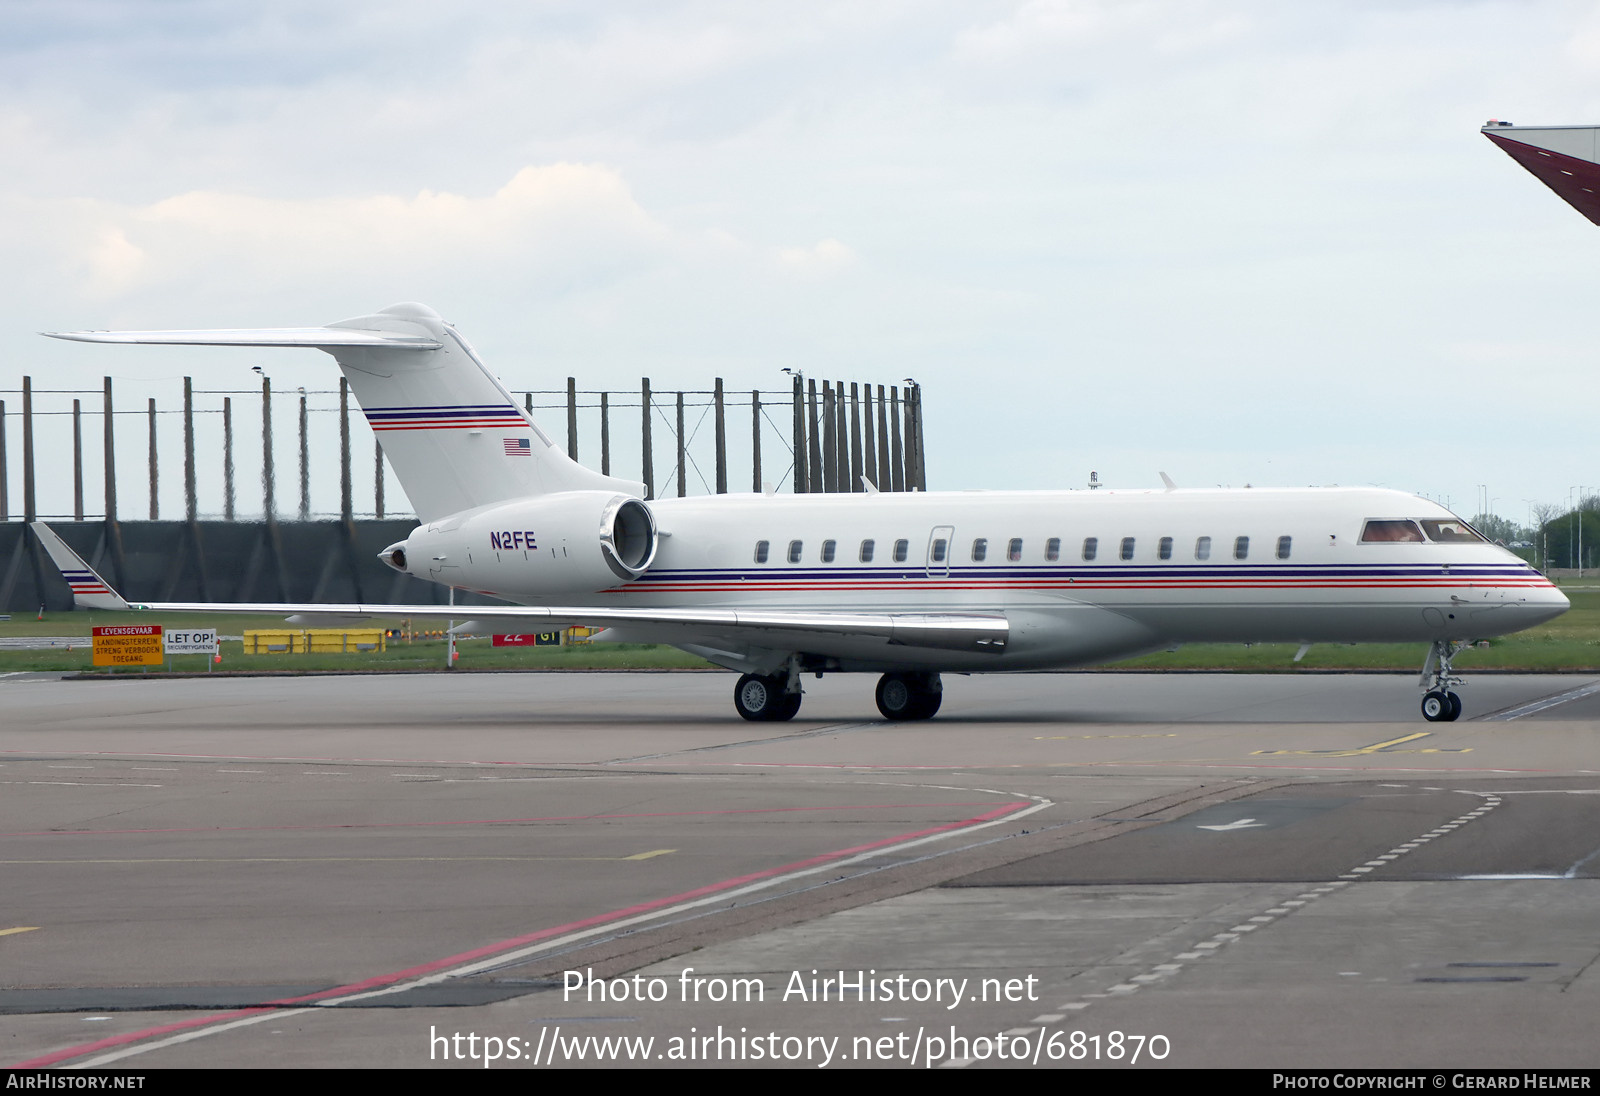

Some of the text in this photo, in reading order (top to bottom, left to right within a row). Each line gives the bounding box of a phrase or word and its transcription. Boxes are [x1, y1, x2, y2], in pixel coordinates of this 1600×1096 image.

[490, 531, 538, 550] N2FE
[101, 627, 153, 635] LEVENSGEVAAR
[97, 638, 158, 646] LANDINGSTERREIN
[167, 633, 214, 643] LET OP!
[95, 646, 160, 655] STRENG VERBODEN
[112, 655, 143, 663] TOEGANG
